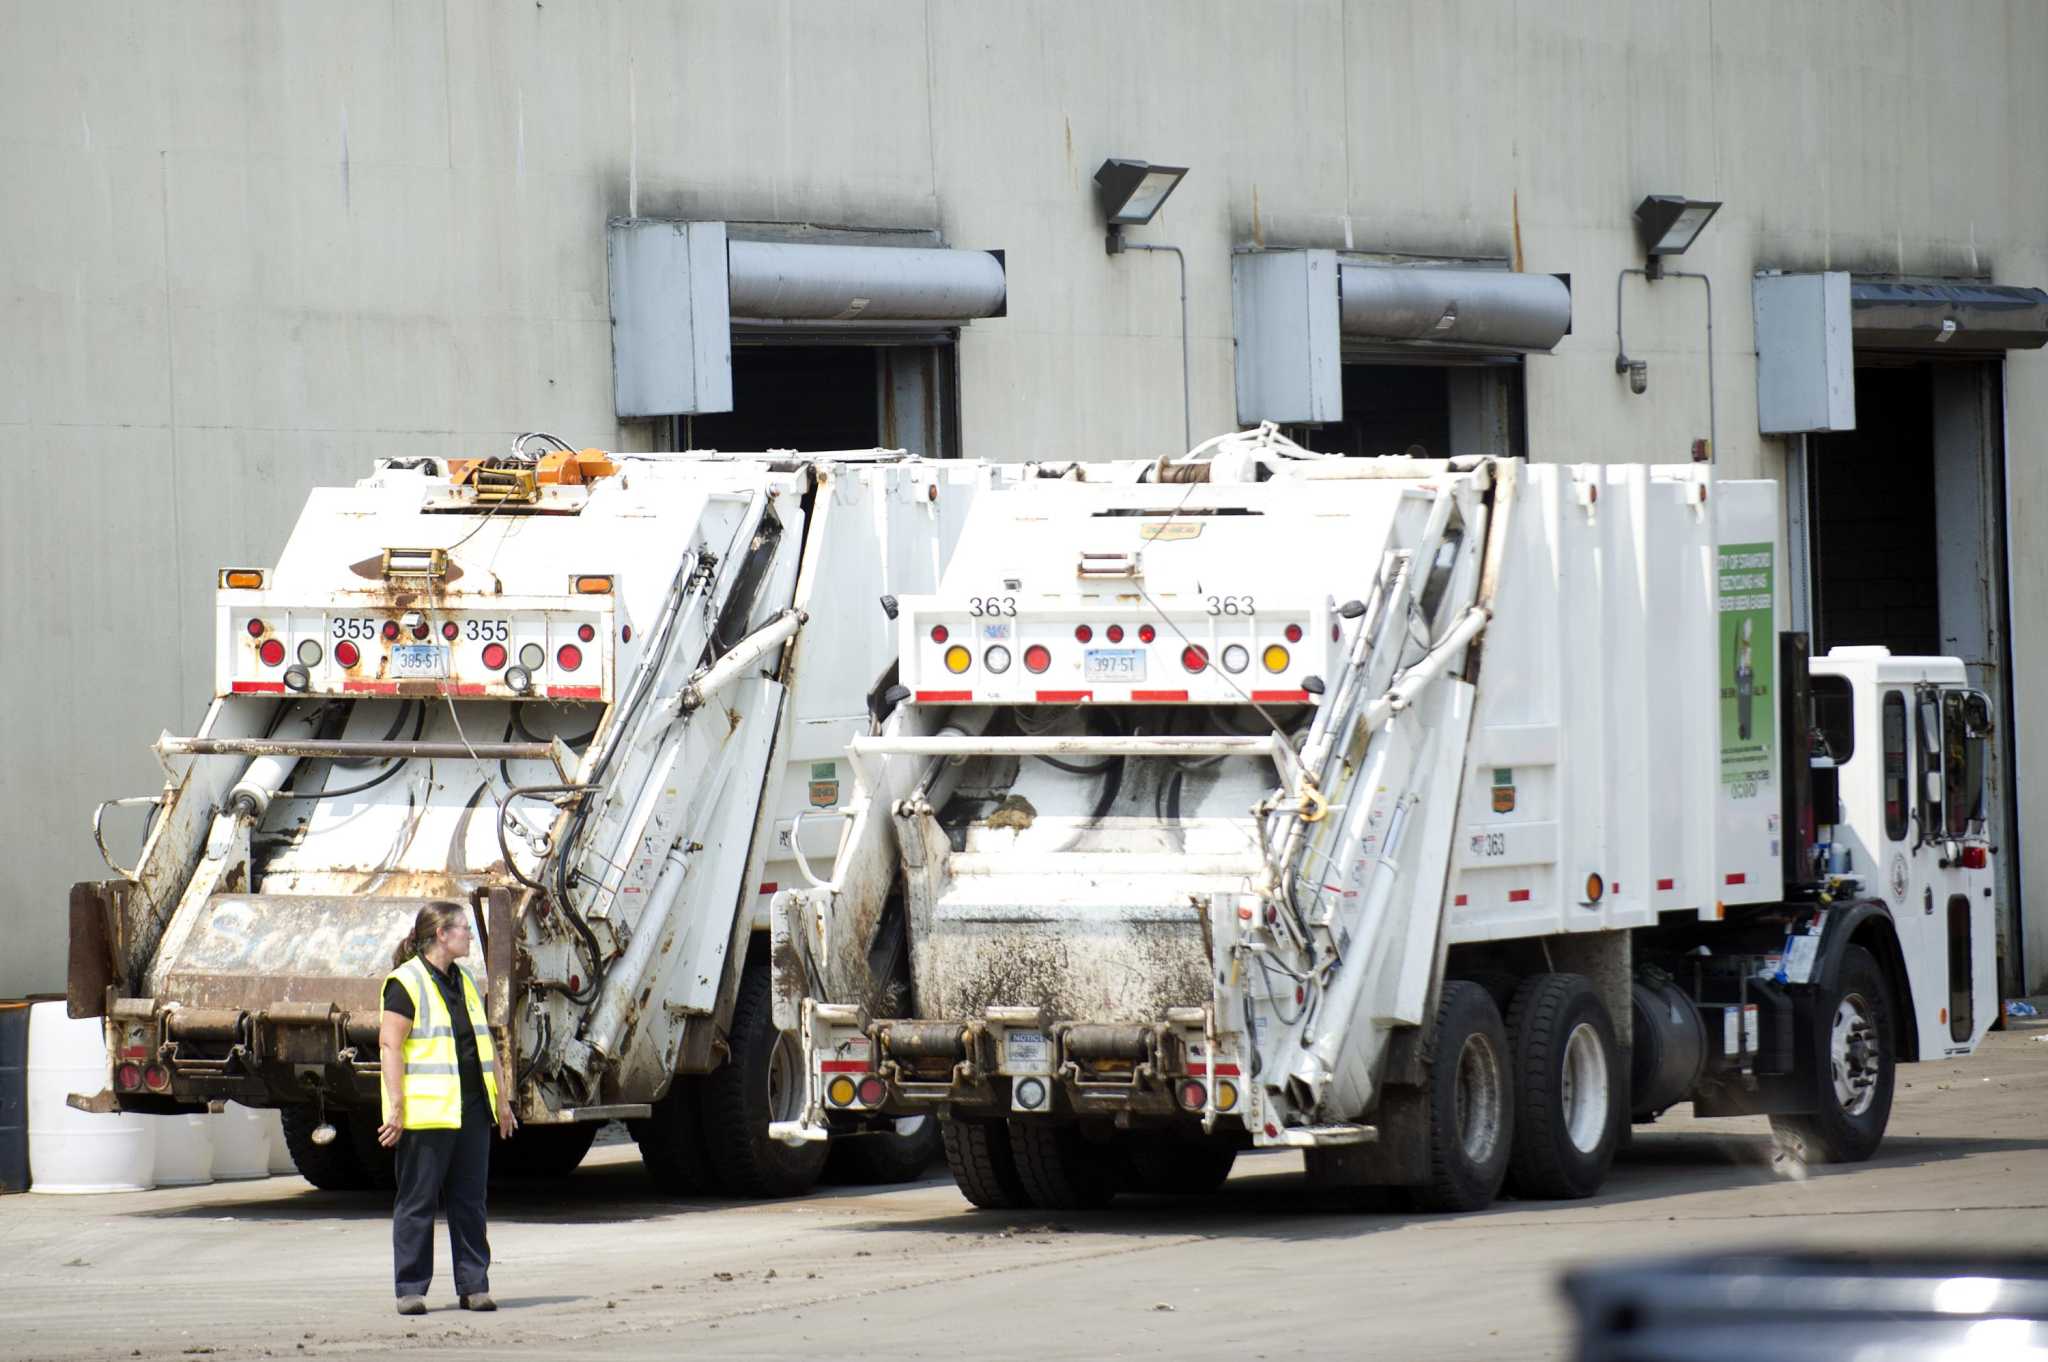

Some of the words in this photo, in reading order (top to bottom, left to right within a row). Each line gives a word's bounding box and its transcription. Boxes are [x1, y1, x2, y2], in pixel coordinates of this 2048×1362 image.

[969, 597, 1017, 617] 363
[1207, 596, 1255, 616] 363
[332, 617, 375, 639] 355
[466, 619, 508, 641] 355
[1486, 833, 1504, 856] 363
